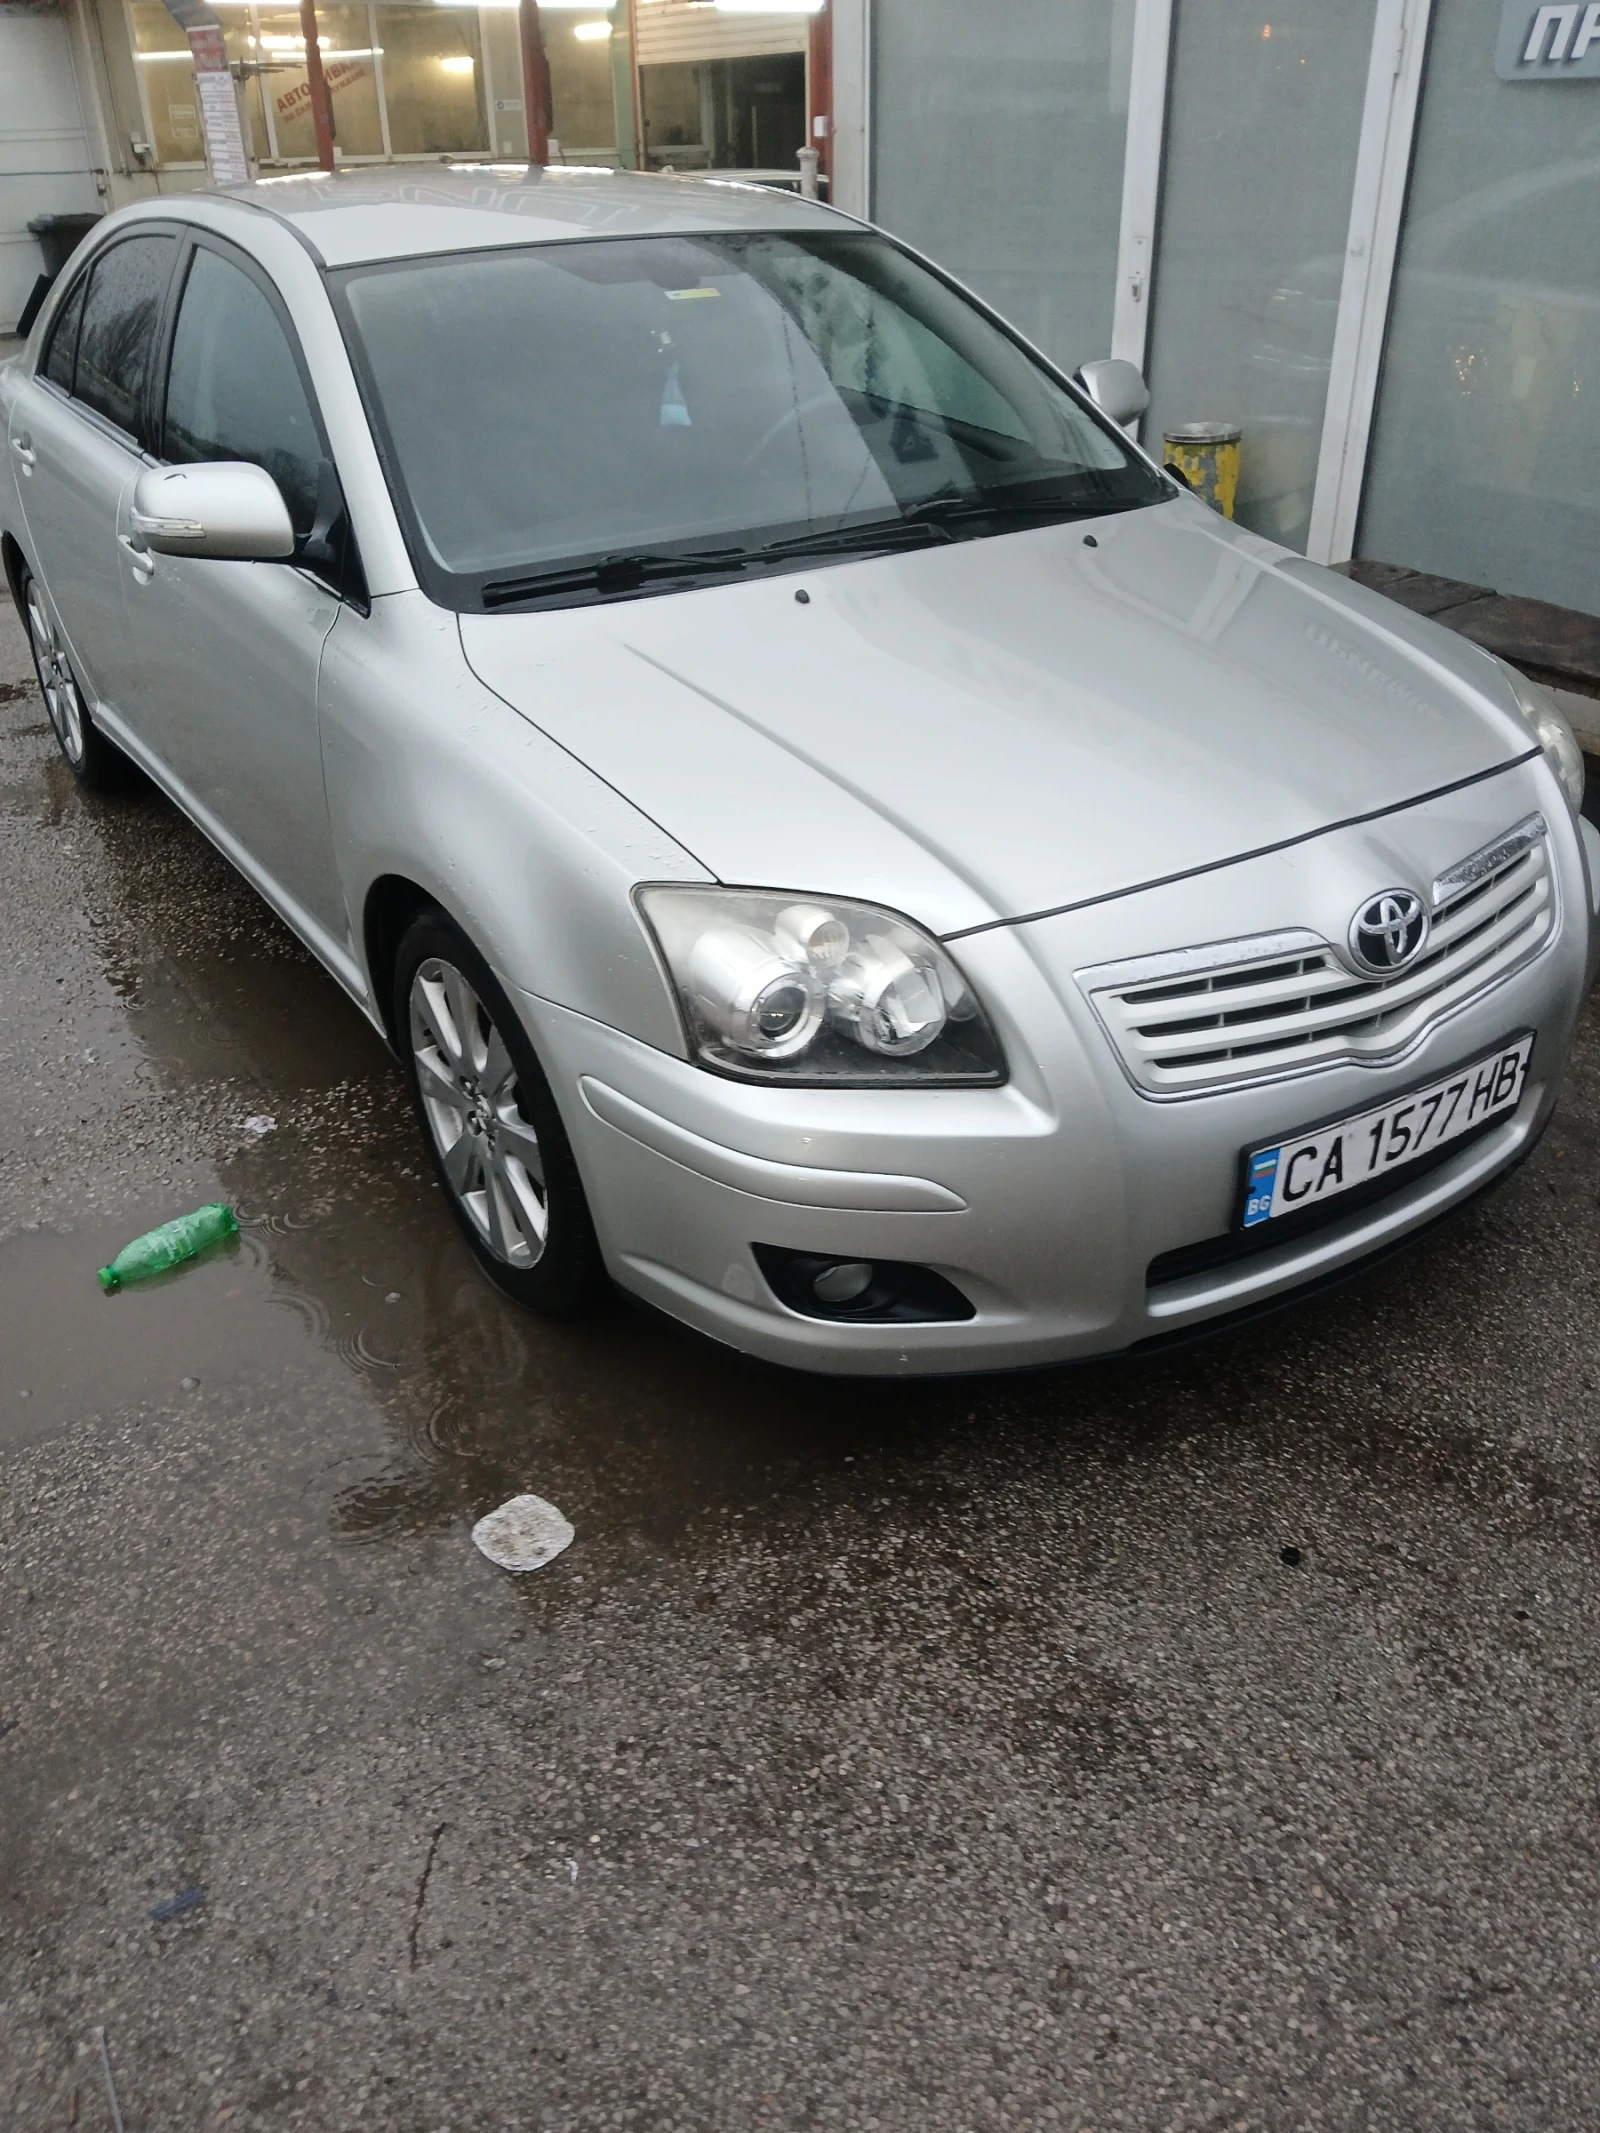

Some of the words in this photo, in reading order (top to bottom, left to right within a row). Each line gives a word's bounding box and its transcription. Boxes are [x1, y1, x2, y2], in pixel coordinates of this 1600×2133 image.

[1282, 1136, 1344, 1202] CA
[1368, 1078, 1469, 1172] 1577
[1467, 1051, 1521, 1121] HB
[1247, 1195, 1271, 1215] BG
